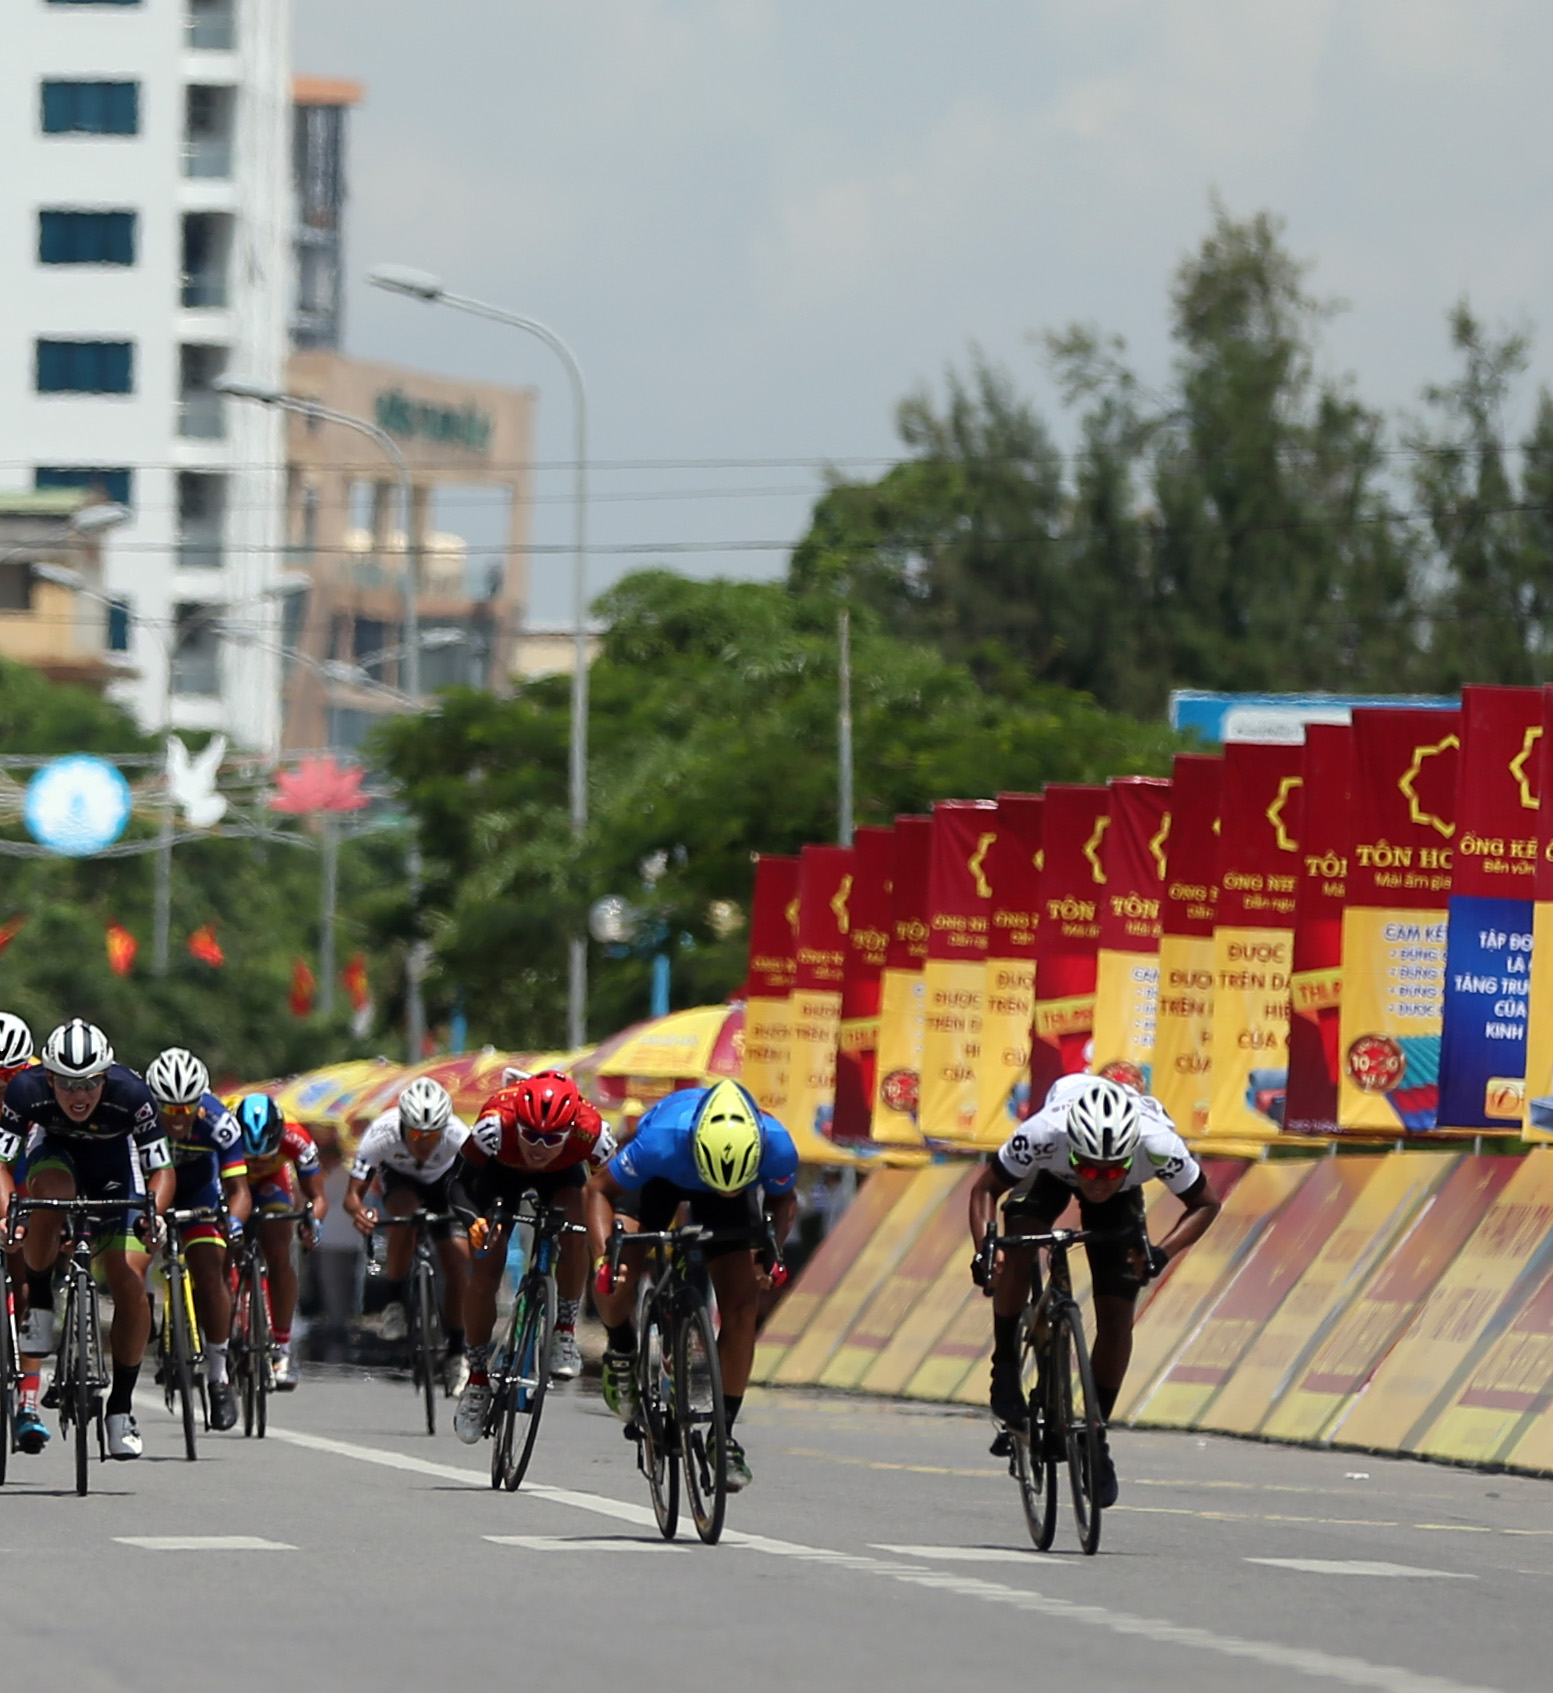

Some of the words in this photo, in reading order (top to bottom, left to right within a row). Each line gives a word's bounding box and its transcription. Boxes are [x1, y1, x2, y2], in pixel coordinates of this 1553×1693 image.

[1356, 838, 1413, 868] TÔN
[1048, 893, 1096, 921] TÔN
[1111, 891, 1160, 918] TÔN
[1220, 968, 1266, 990] TRÊN
[1485, 1021, 1524, 1041] KINH
[140, 1143, 167, 1169] 71
[1156, 1156, 1184, 1181] 63
